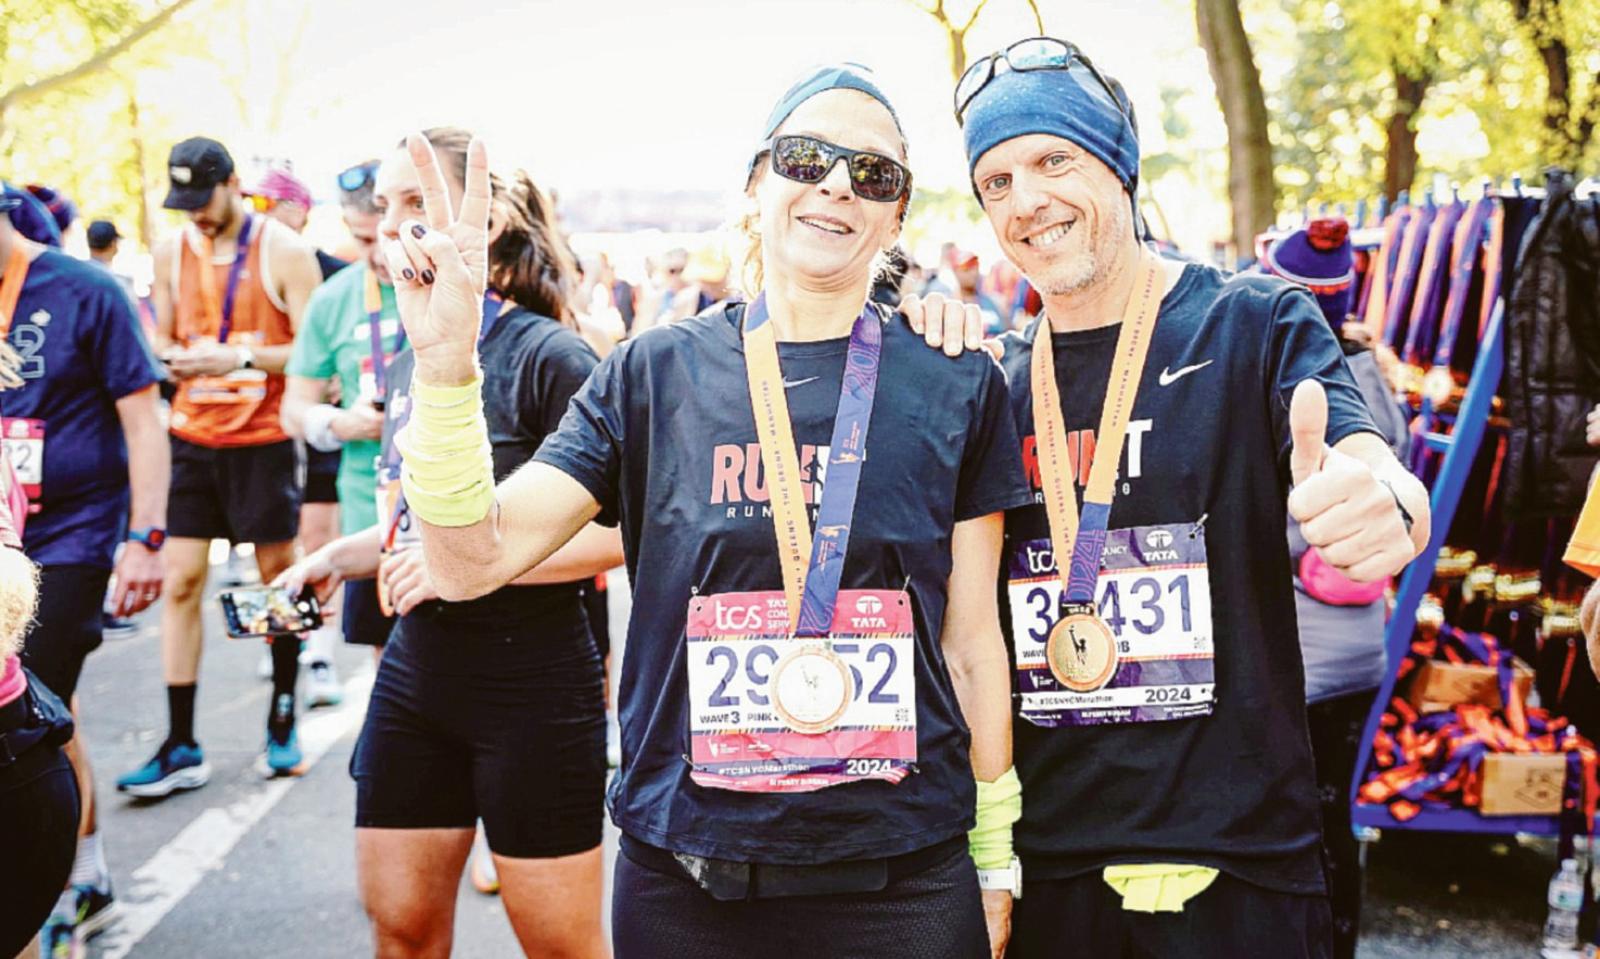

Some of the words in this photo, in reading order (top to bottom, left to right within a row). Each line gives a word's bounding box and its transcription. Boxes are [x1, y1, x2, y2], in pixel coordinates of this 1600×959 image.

[1026, 546, 1059, 573] tc
[1143, 550, 1178, 562] TATA
[715, 600, 762, 630] tcs
[1026, 574, 1191, 643] 3431
[851, 617, 887, 628] TATA
[1145, 688, 1192, 703] 2024
[699, 713, 729, 724] WAVE
[730, 711, 740, 724] 3
[747, 712, 772, 722] PINK
[846, 759, 892, 775] 2024
